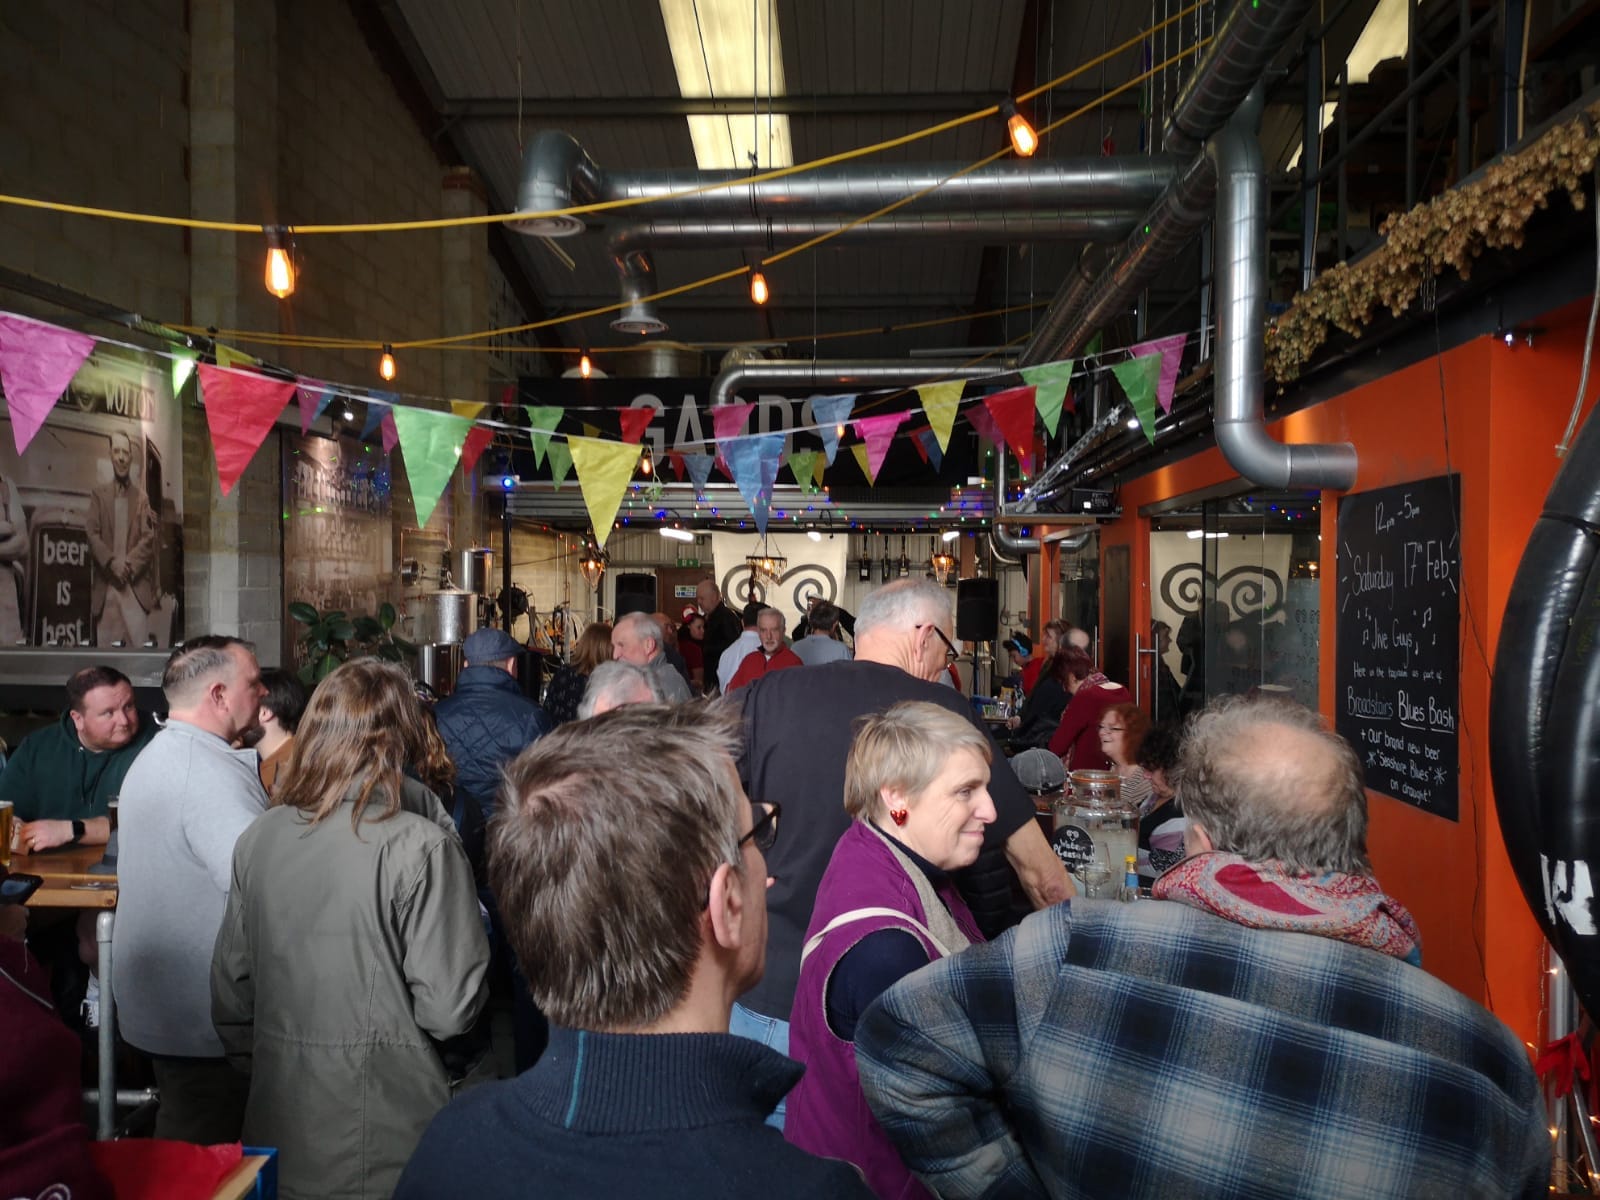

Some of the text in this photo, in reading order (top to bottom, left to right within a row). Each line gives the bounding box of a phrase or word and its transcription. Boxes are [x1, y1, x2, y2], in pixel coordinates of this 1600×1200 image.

[629, 392, 835, 470] GAD
[43, 533, 89, 566] beer
[1353, 552, 1394, 611] Saturday
[1426, 540, 1449, 583] Feb
[42, 616, 85, 648] best
[1353, 659, 1366, 679] Here
[1376, 667, 1385, 679] the
[1422, 669, 1434, 681] part
[1347, 685, 1455, 731] Broadstairs Blues Bash
[1367, 728, 1382, 744] Our
[1384, 730, 1405, 751] brand
[1407, 741, 1421, 755] new
[1424, 743, 1441, 760] beer
[1390, 778, 1432, 805] on draught!
